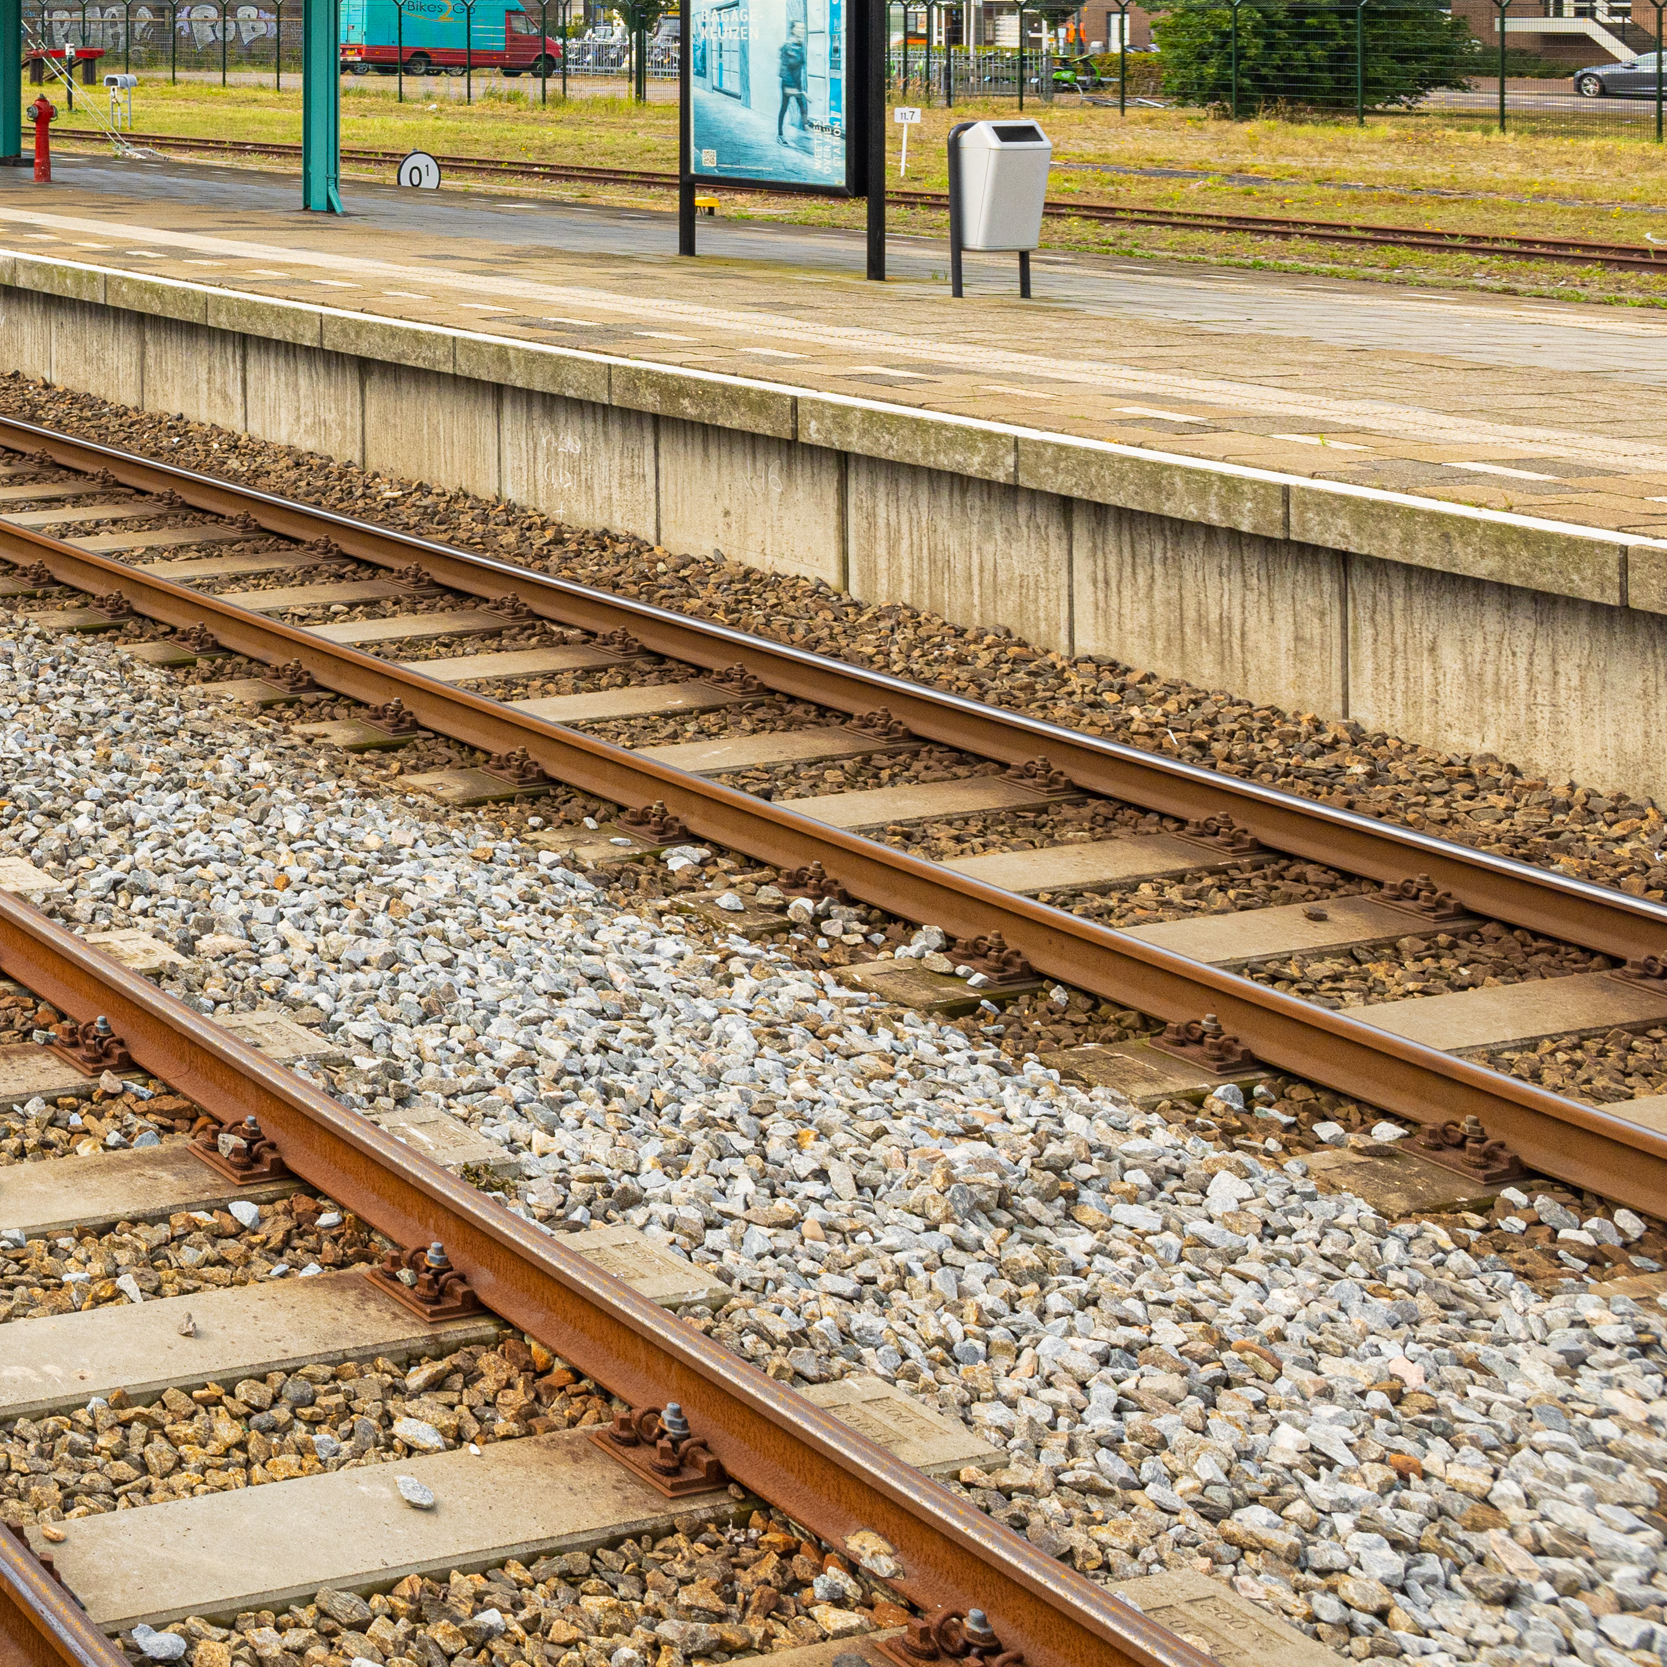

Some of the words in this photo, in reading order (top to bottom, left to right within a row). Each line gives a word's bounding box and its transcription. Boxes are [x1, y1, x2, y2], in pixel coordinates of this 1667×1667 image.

[700, 26, 760, 41] KLUIZEN
[813, 120, 822, 170] WEETJES
[823, 122, 832, 143] HET
[823, 145, 832, 174] OVER
